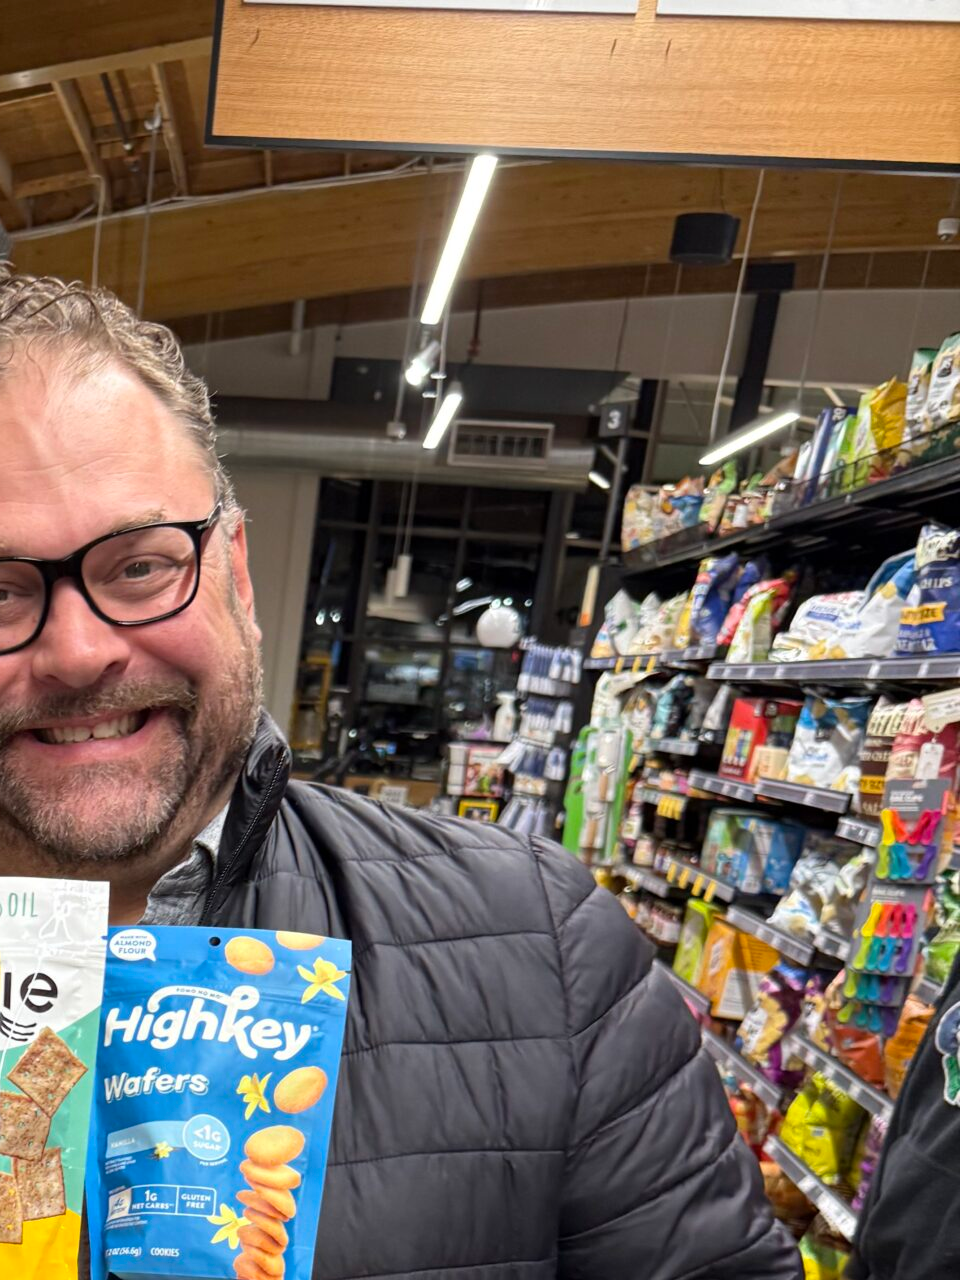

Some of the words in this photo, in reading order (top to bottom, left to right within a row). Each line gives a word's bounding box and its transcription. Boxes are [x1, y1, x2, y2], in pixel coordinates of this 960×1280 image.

[607, 409, 622, 431] 3
[8, 892, 39, 918] OIL
[114, 940, 152, 948] ALMOND
[104, 1066, 210, 1103] Wafers
[181, 1193, 211, 1202] GLUTEN
[150, 1248, 180, 1257] COOKIES
